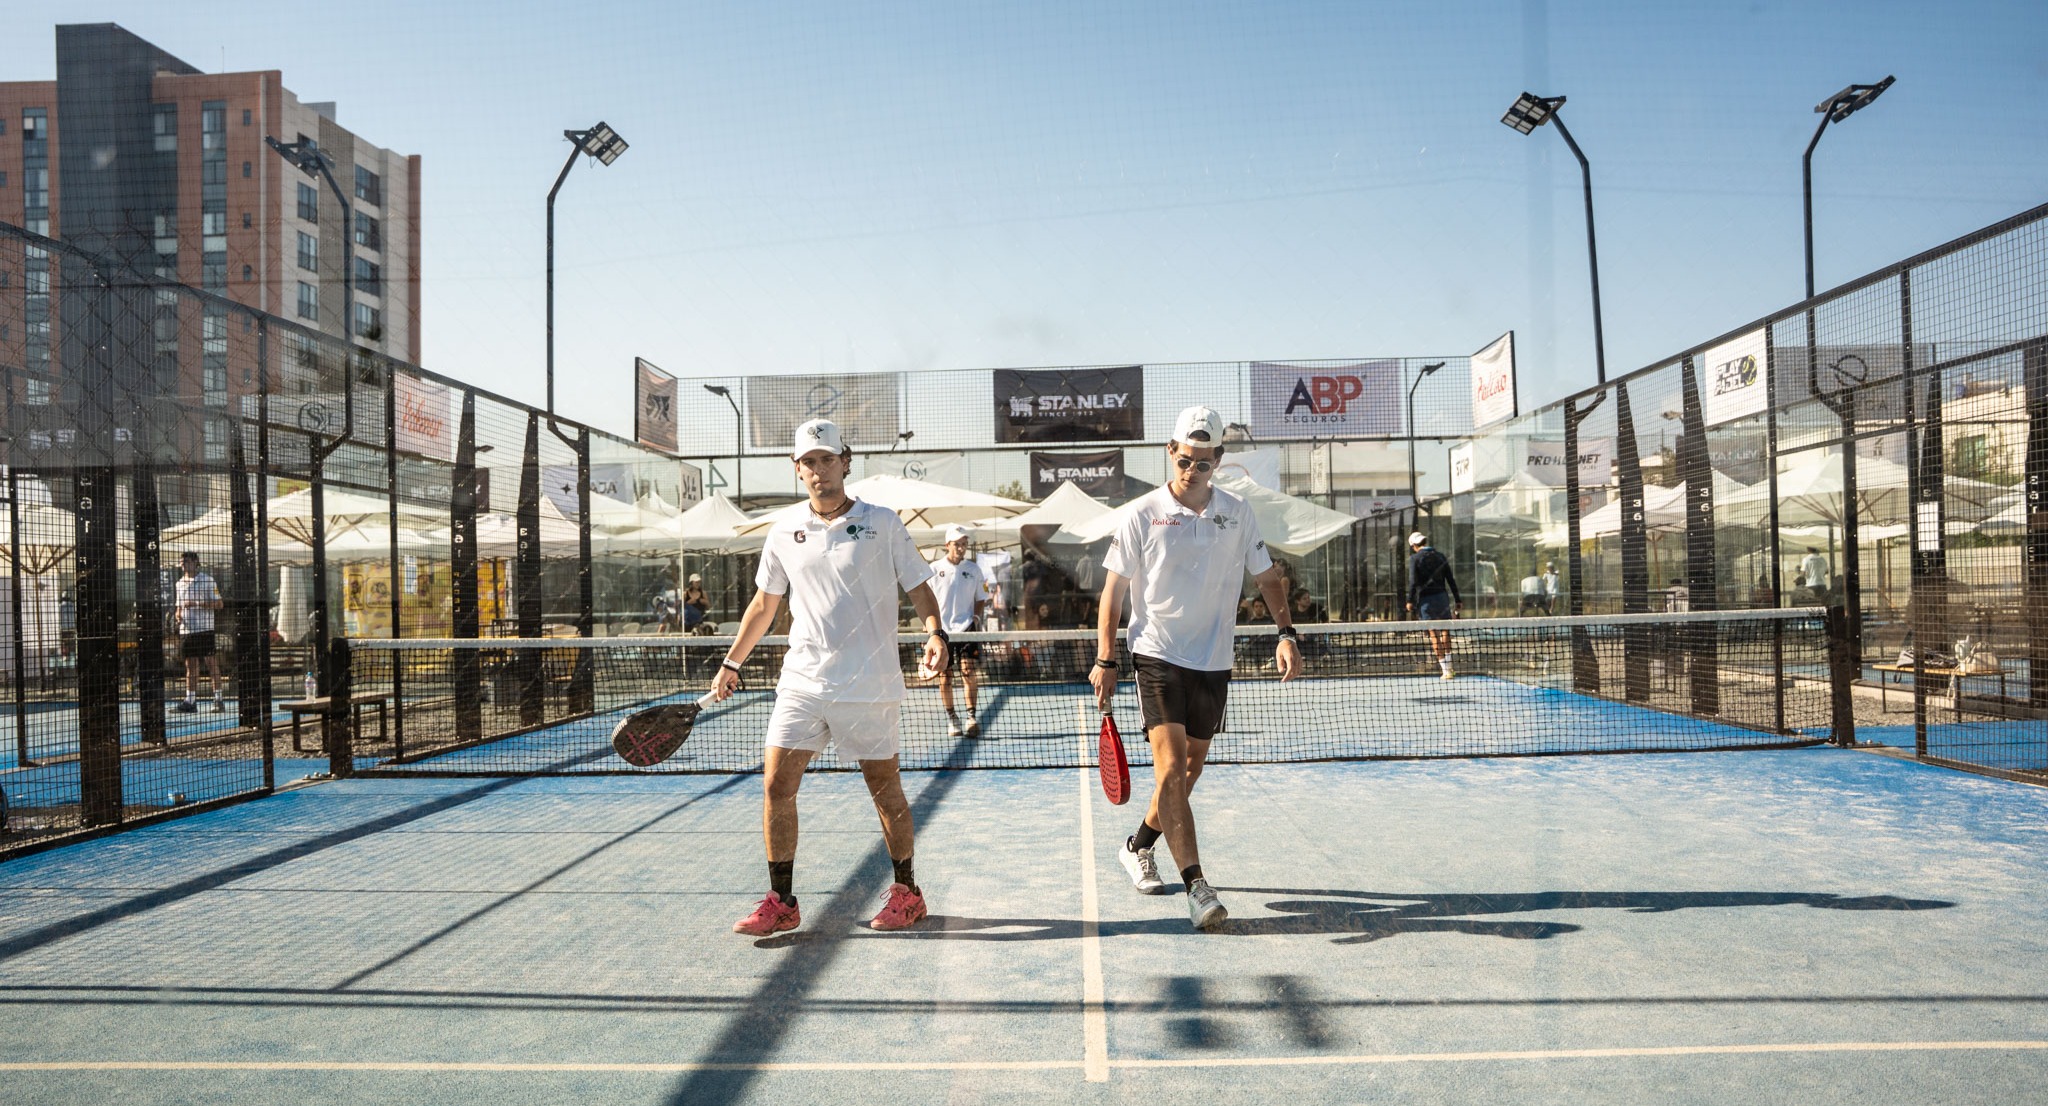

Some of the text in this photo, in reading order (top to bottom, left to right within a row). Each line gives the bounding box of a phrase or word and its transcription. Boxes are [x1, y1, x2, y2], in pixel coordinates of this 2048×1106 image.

[1038, 393, 1128, 410] STANLEY
[1284, 376, 1363, 414] ABP
[1284, 415, 1347, 423] SEGUROS
[1057, 467, 1115, 478] STANLEY
